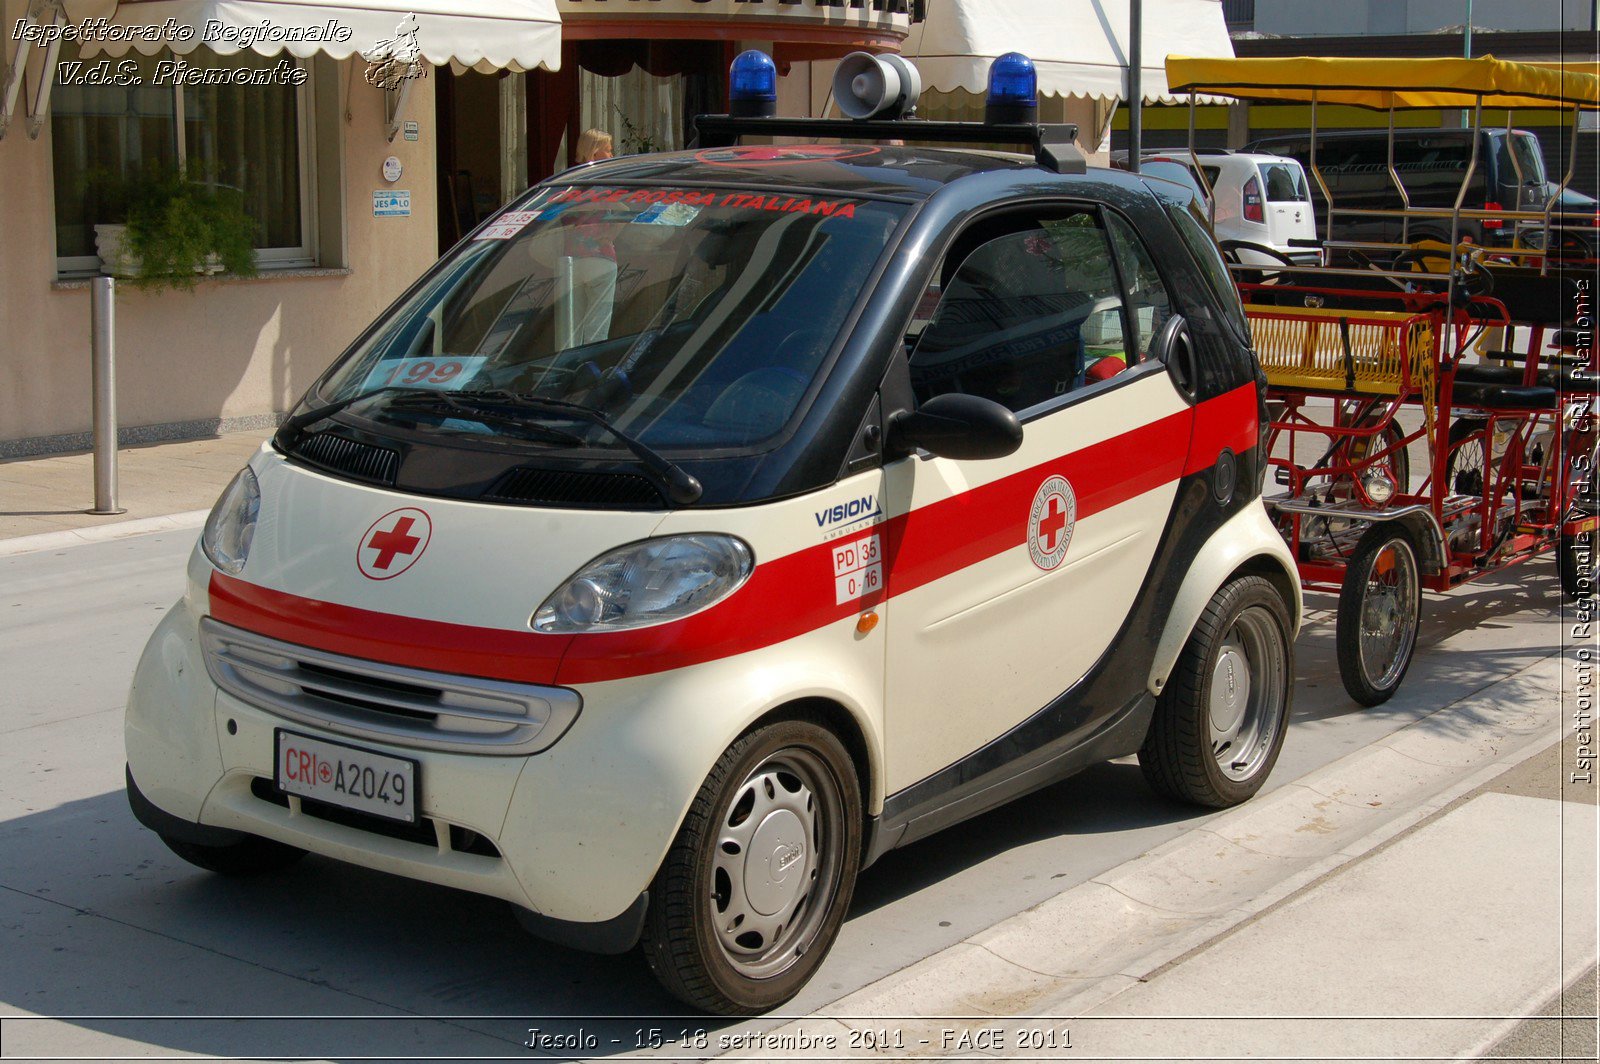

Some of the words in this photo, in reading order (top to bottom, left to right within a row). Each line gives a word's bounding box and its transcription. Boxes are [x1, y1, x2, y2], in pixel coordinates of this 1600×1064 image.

[546, 189, 629, 203] CROCE
[625, 189, 716, 206] ROSSA
[719, 193, 856, 218] ITALIANA
[383, 361, 462, 384] 199
[815, 495, 872, 527] VISION
[1031, 497, 1043, 526] CROCE
[1042, 481, 1057, 497] ROSSA
[1057, 481, 1074, 512] ITALIANA
[1056, 520, 1074, 557] PADOVA
[836, 549, 855, 570] PD
[861, 541, 877, 561] 35
[286, 748, 317, 786] CRI
[334, 760, 405, 806] A2049
